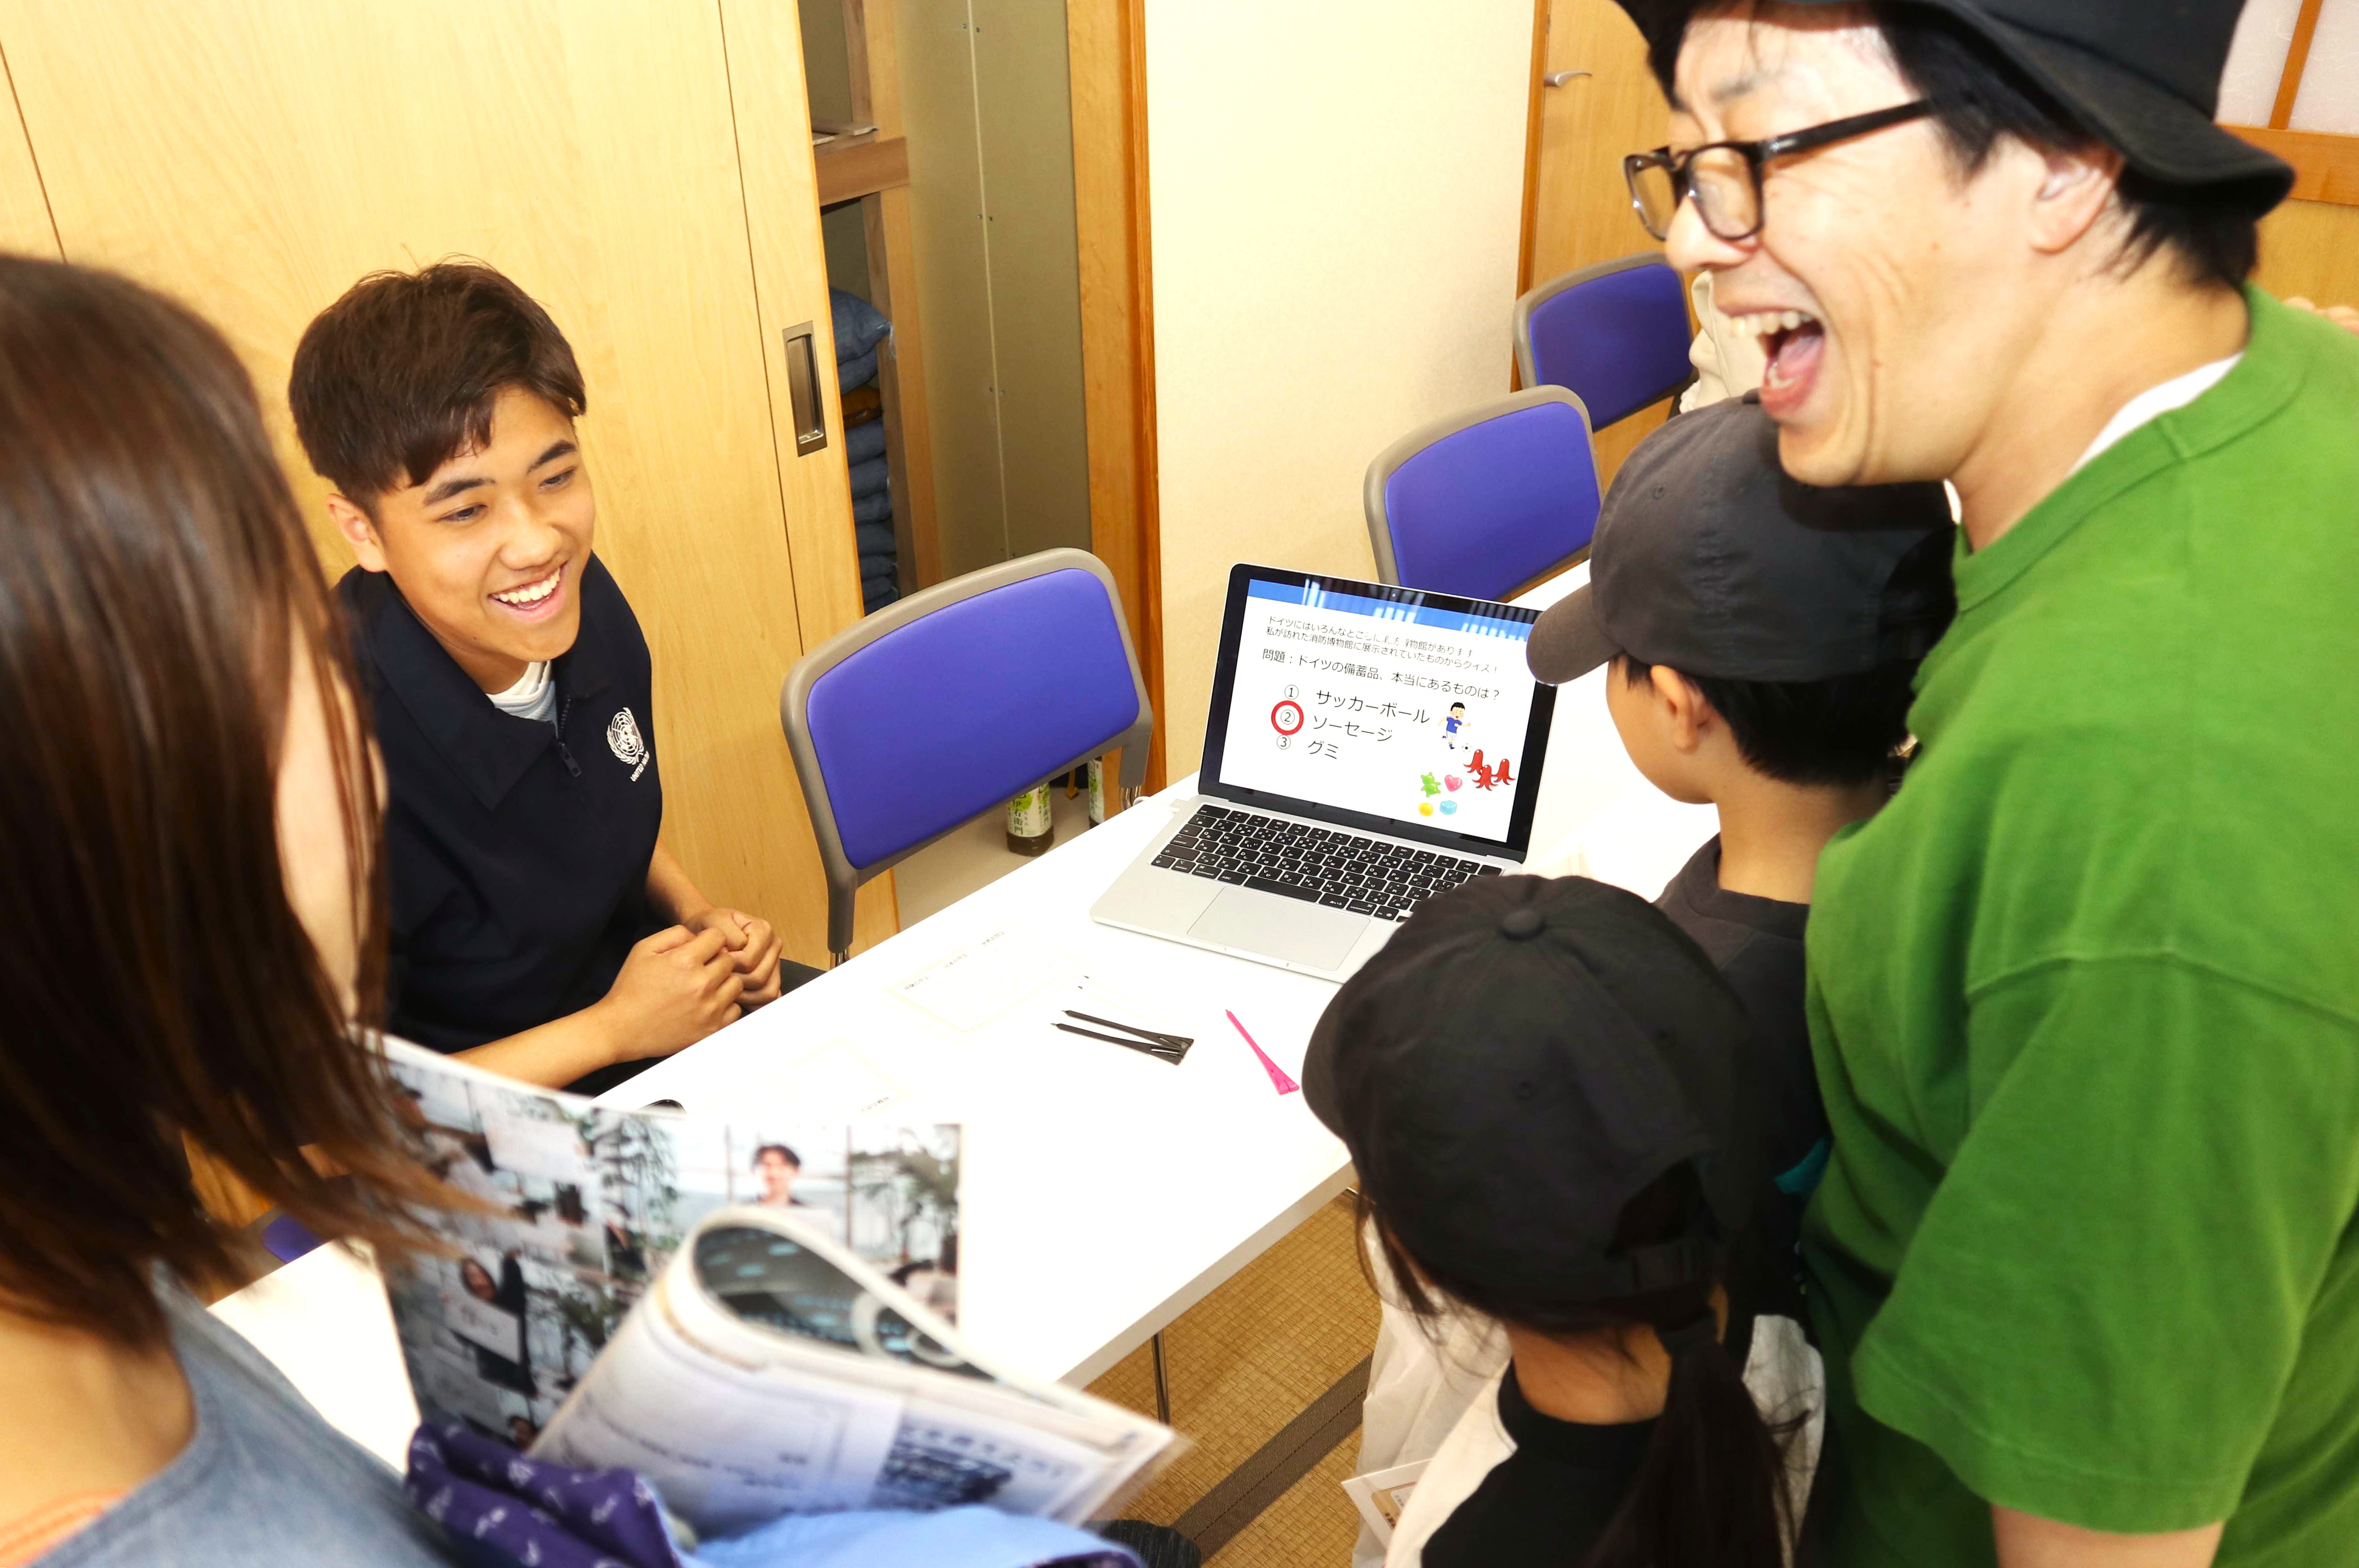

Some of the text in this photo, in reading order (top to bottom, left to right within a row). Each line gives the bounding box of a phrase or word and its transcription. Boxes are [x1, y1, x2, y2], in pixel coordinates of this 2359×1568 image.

[1316, 690, 1430, 723] サッカーボール
[1313, 715, 1393, 741] ソーセージ
[1308, 741, 1338, 760] グミ
